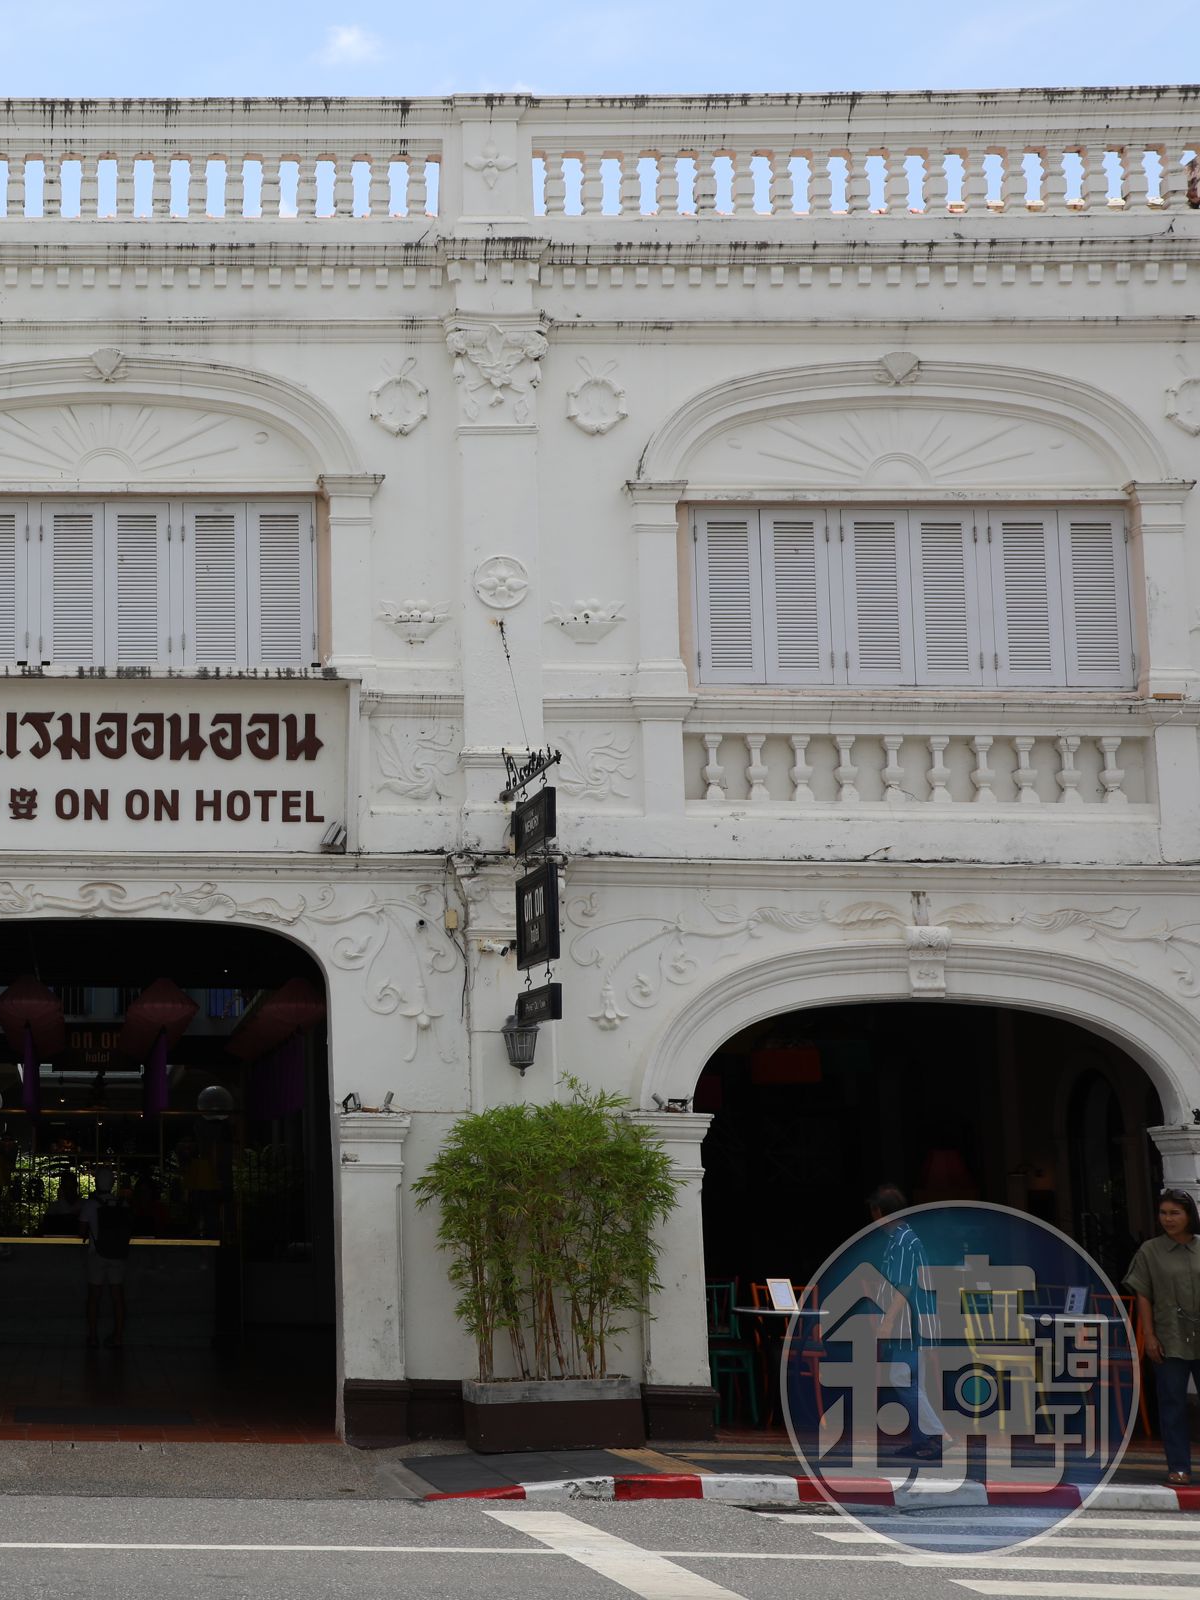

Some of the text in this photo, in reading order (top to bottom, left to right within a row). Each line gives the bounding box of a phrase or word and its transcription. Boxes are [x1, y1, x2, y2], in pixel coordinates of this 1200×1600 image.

[55, 788, 325, 823] ON ON HOTEL
[523, 885, 545, 923] on on
[71, 1031, 93, 1048] on
